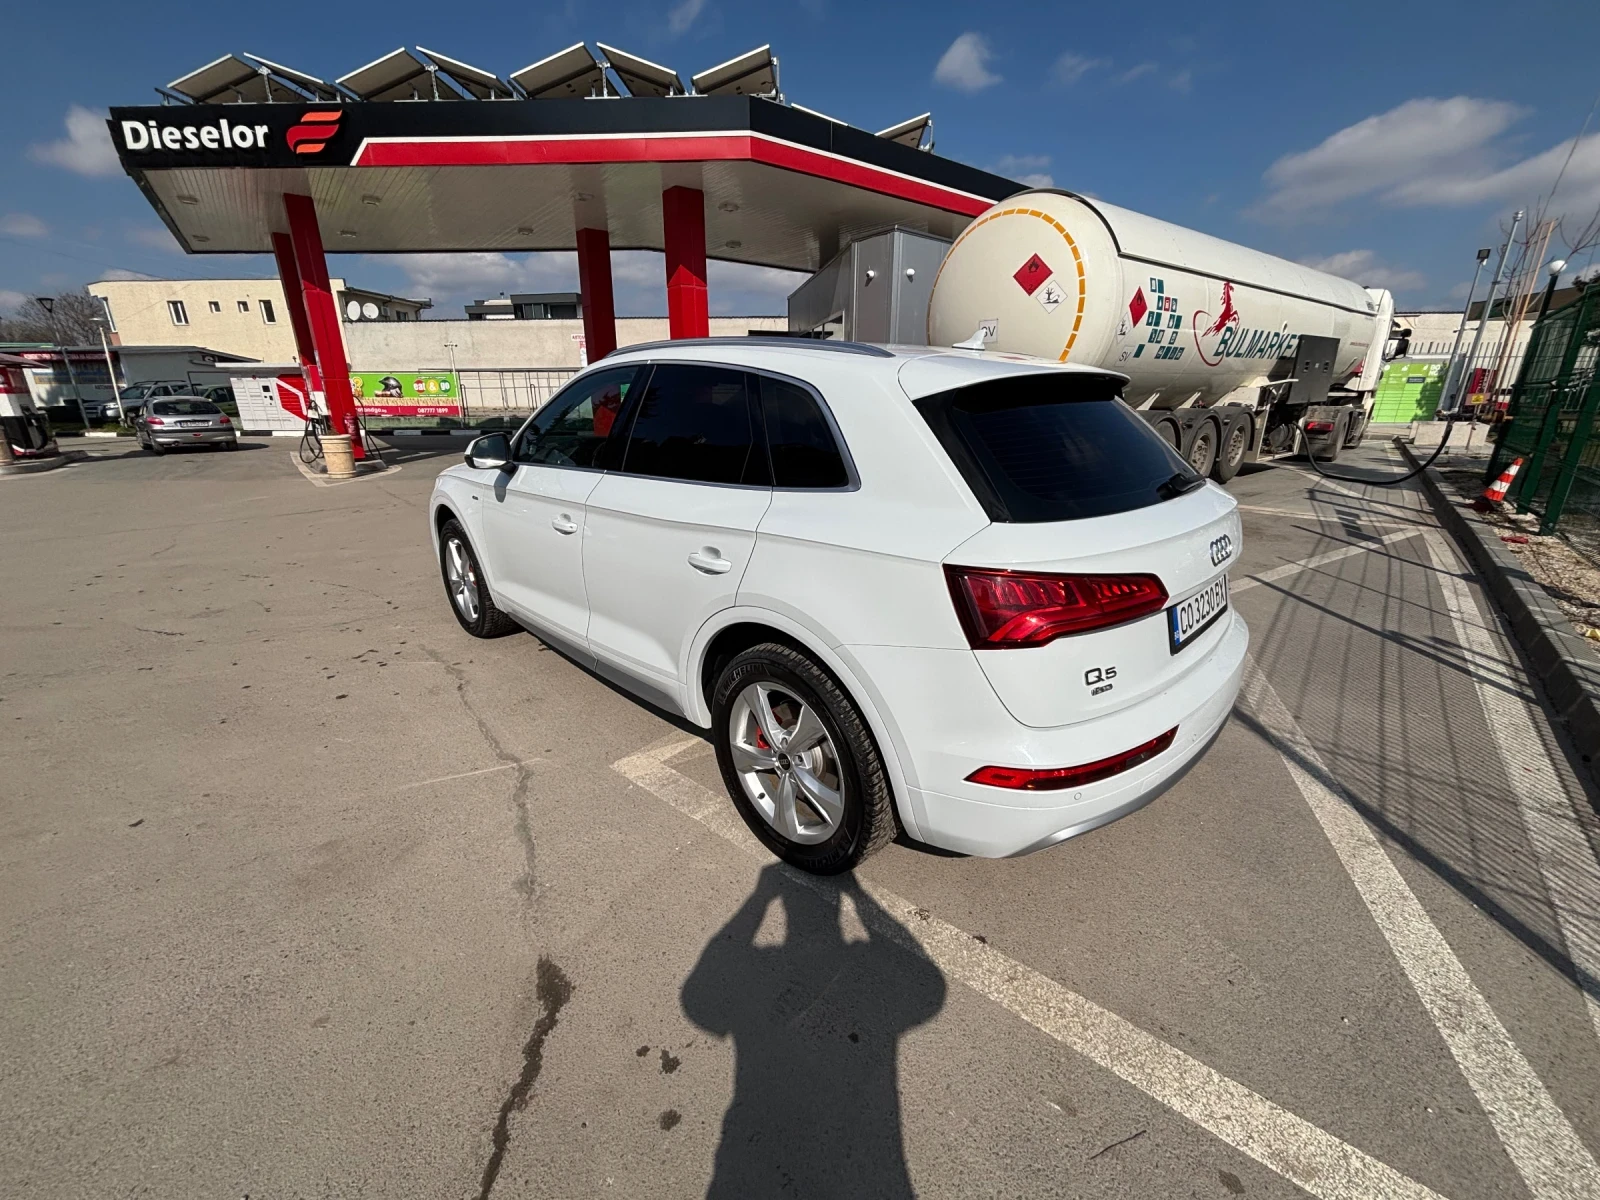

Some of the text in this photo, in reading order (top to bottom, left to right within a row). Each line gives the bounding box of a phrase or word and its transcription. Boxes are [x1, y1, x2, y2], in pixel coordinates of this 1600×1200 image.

[121, 118, 269, 150] Dieselor
[413, 382, 426, 391] eat
[440, 382, 450, 391] go
[1195, 587, 1215, 624] 3230
[723, 663, 764, 692] MICHELIN
[1085, 666, 1117, 686] Q5
